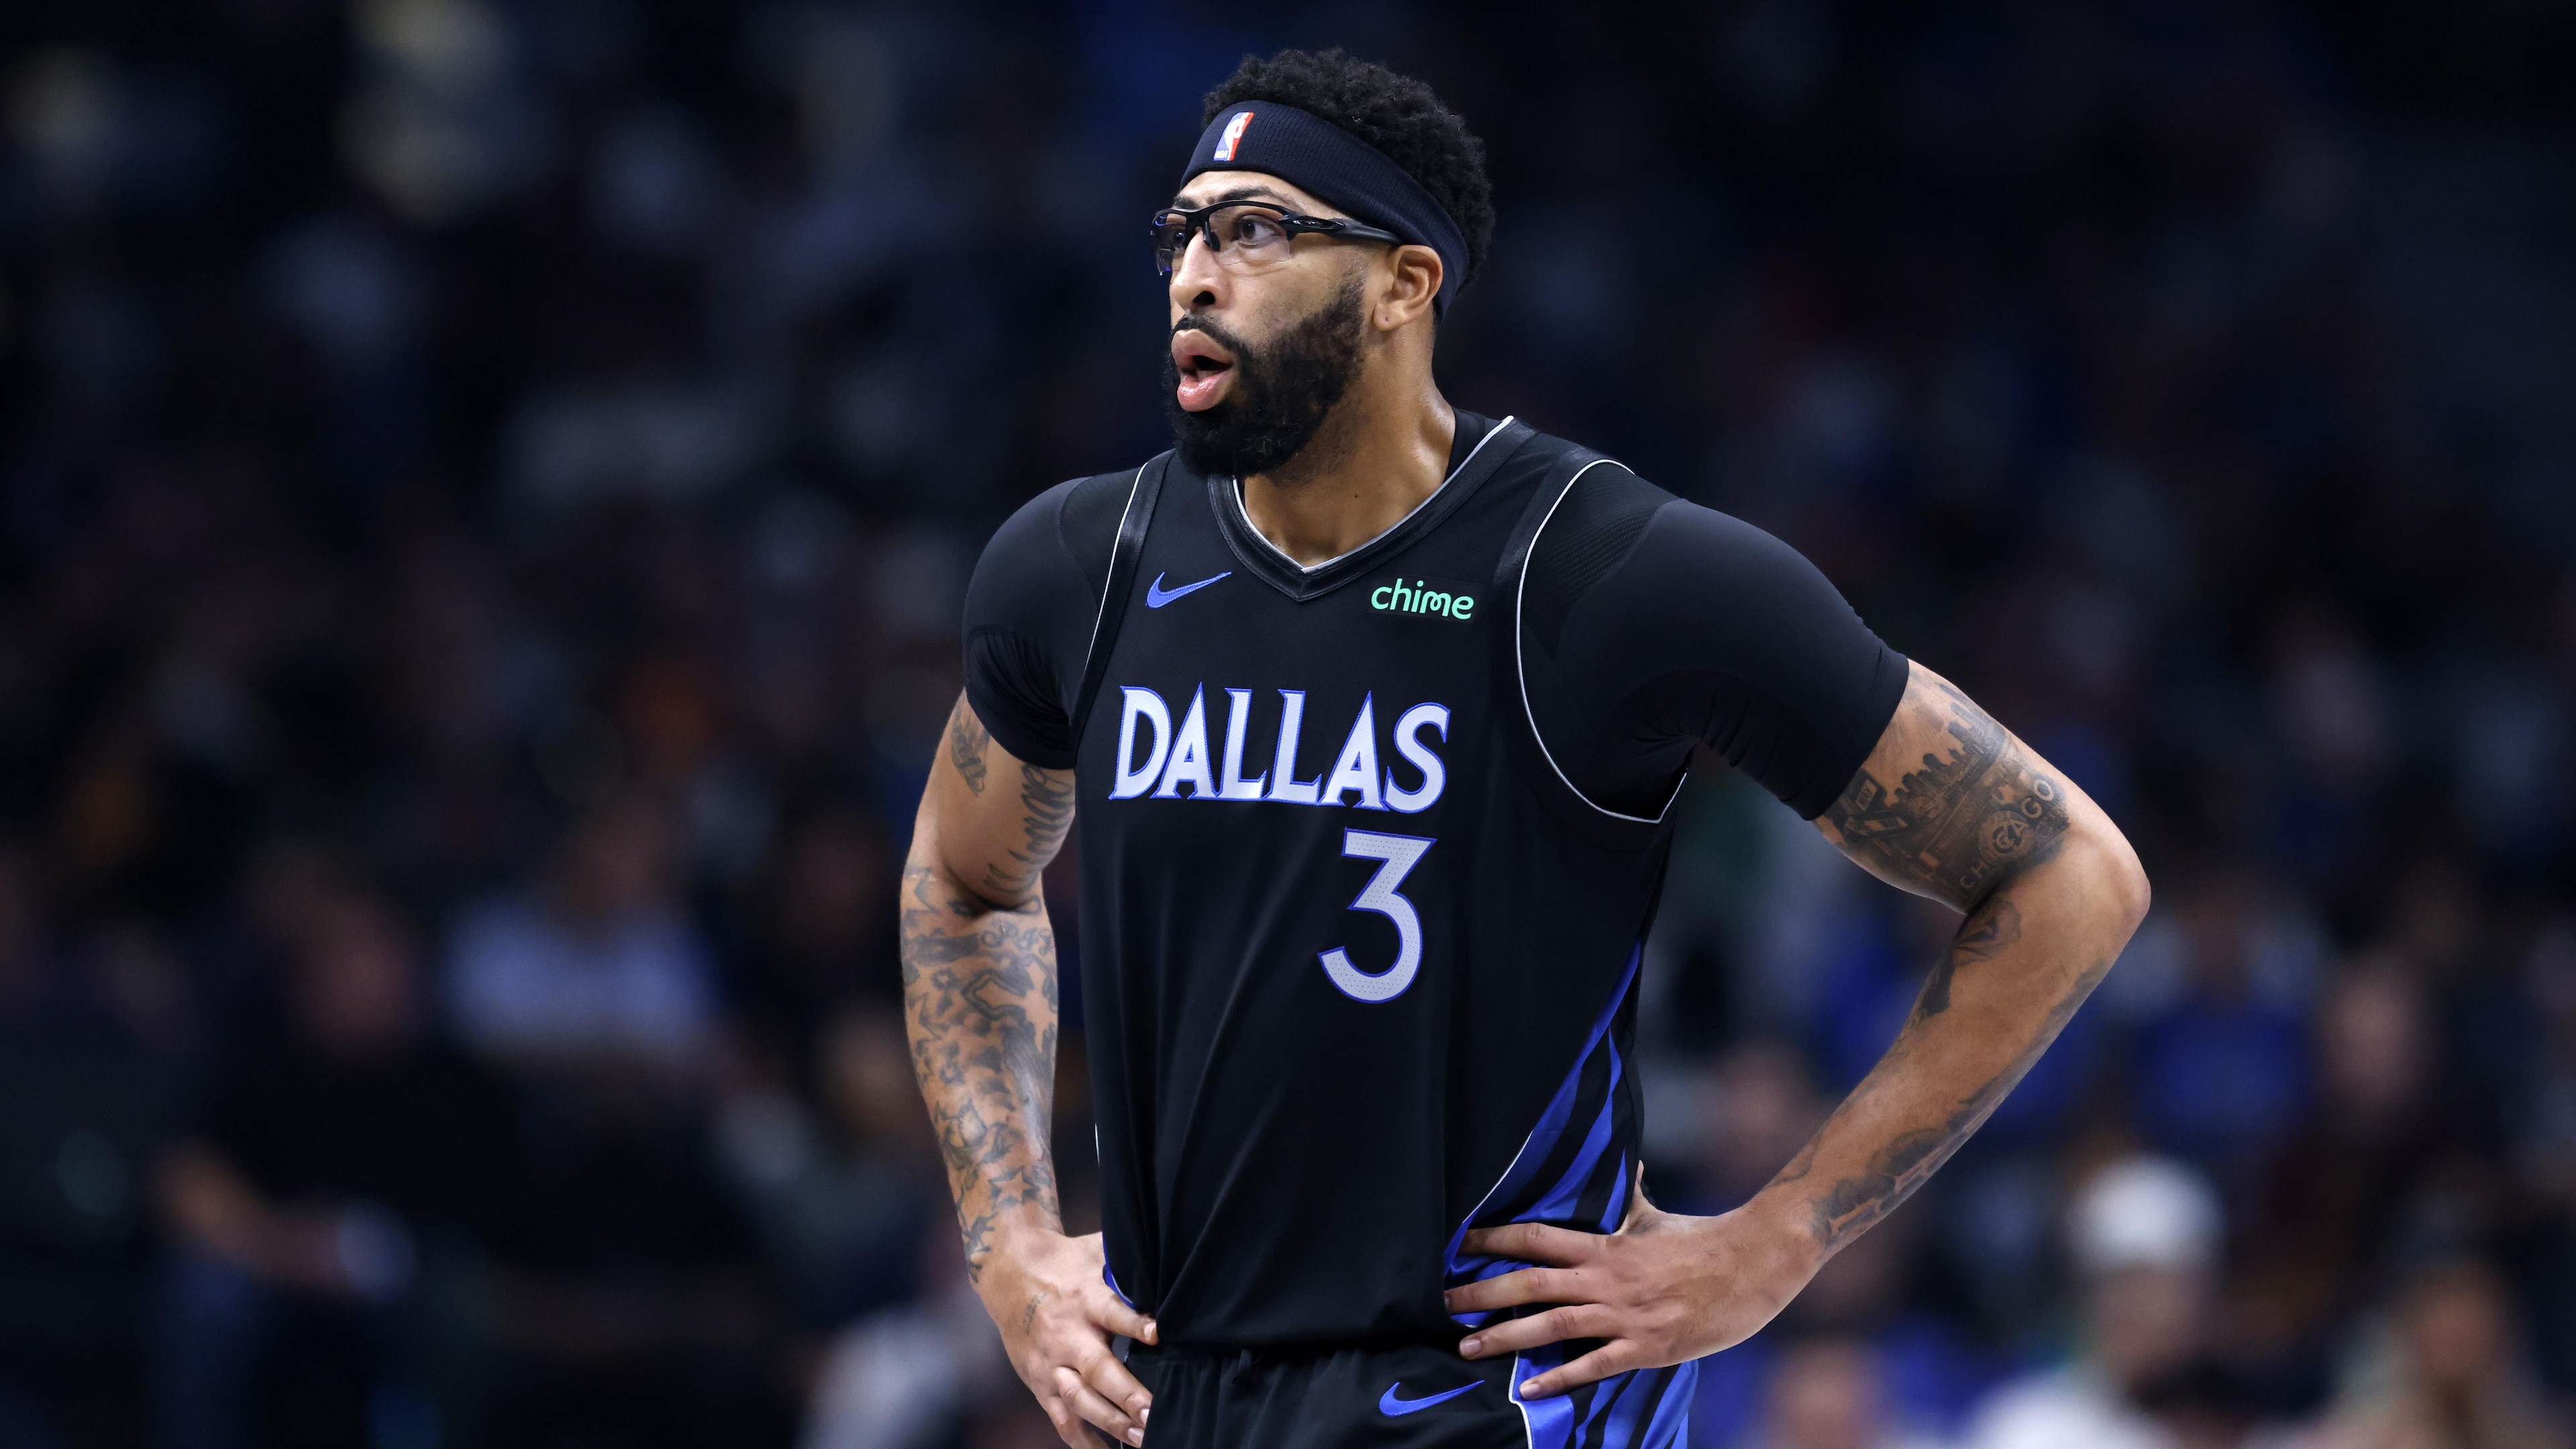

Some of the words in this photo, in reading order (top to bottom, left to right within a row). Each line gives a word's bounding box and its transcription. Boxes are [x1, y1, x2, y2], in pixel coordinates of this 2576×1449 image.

[1371, 578, 1474, 620] chime
[1108, 682, 1450, 813] DALLAS
[1318, 828, 1437, 1004] 3
